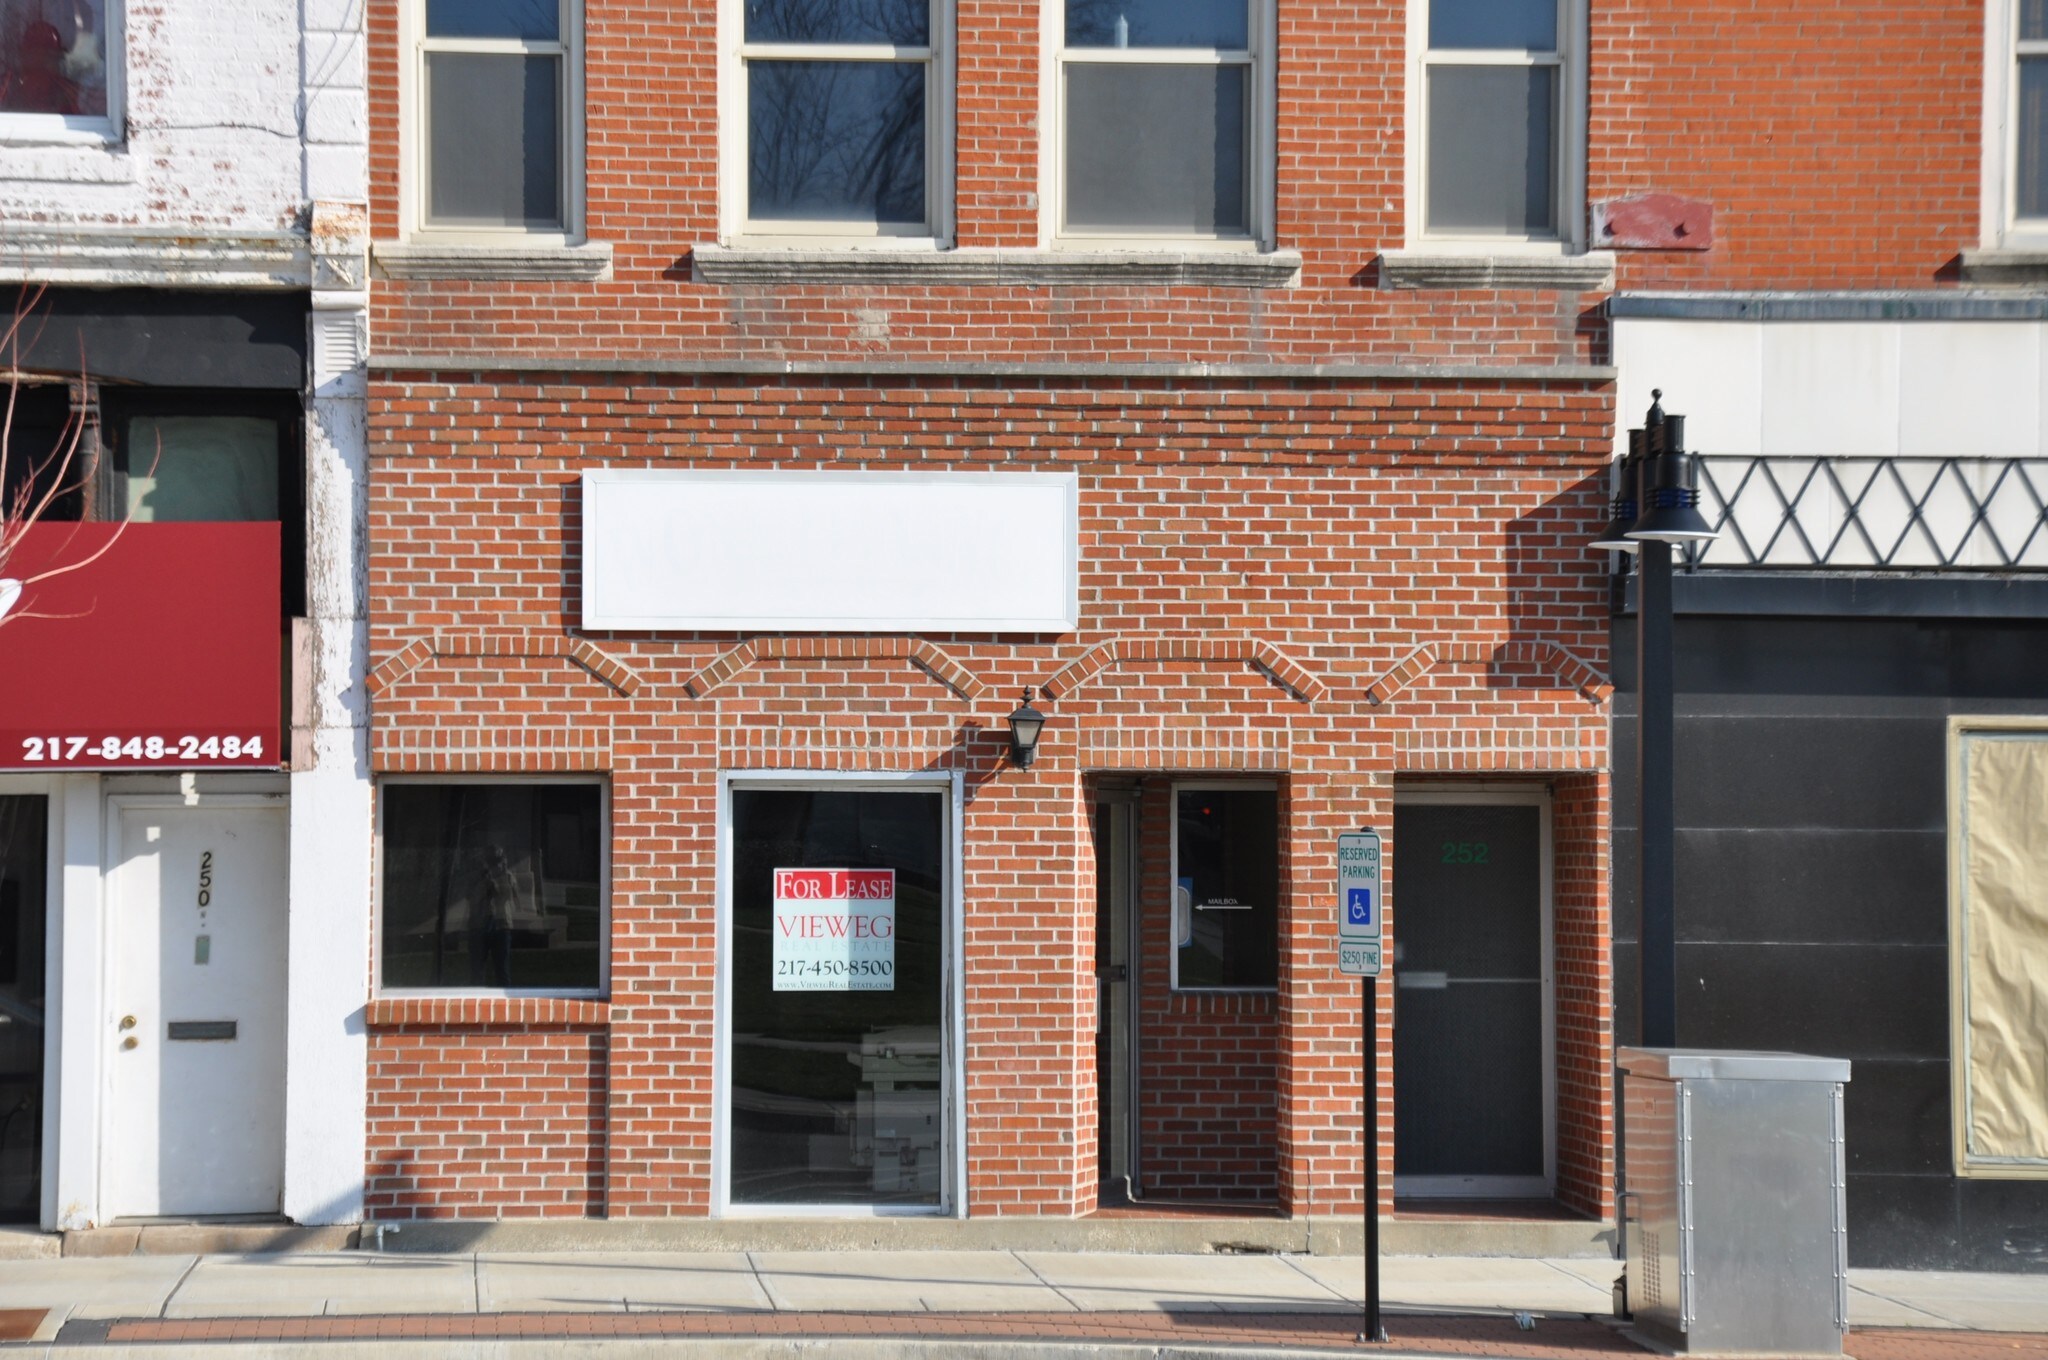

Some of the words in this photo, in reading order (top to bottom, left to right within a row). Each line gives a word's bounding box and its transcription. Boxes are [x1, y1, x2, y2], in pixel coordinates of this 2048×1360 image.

[22, 735, 263, 761] 217-848-2484
[1340, 847, 1378, 861] RESERVED
[1440, 841, 1489, 864] 252
[198, 851, 212, 907] 250
[1342, 865, 1375, 879] PARKING
[777, 915, 892, 939] VIEWEG
[780, 941, 821, 952] REAL
[831, 941, 892, 952] ESTATE
[1341, 951, 1361, 965] $250
[1362, 951, 1378, 966] FINE
[777, 960, 893, 976] 217-450-8500
